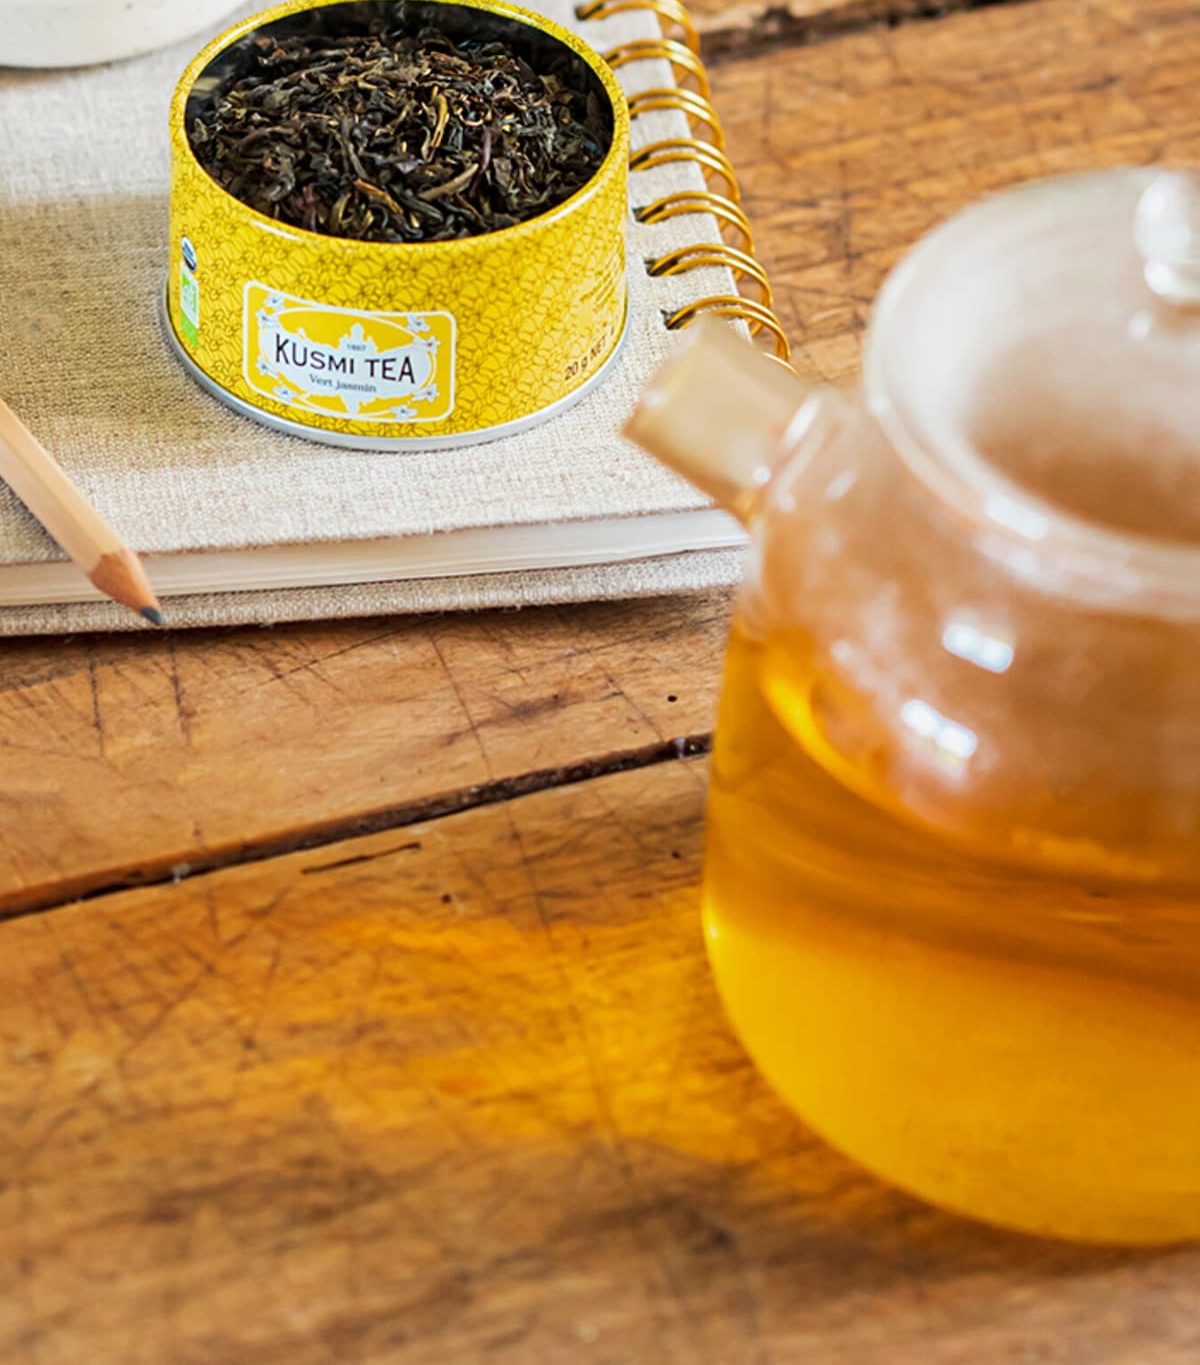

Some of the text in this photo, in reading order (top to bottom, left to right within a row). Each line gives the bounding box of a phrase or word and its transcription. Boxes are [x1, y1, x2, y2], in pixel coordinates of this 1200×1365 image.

[275, 333, 416, 384] KUSMI TEA
[564, 361, 579, 380] 20
[590, 335, 606, 361] NET
[309, 374, 333, 388] Vert
